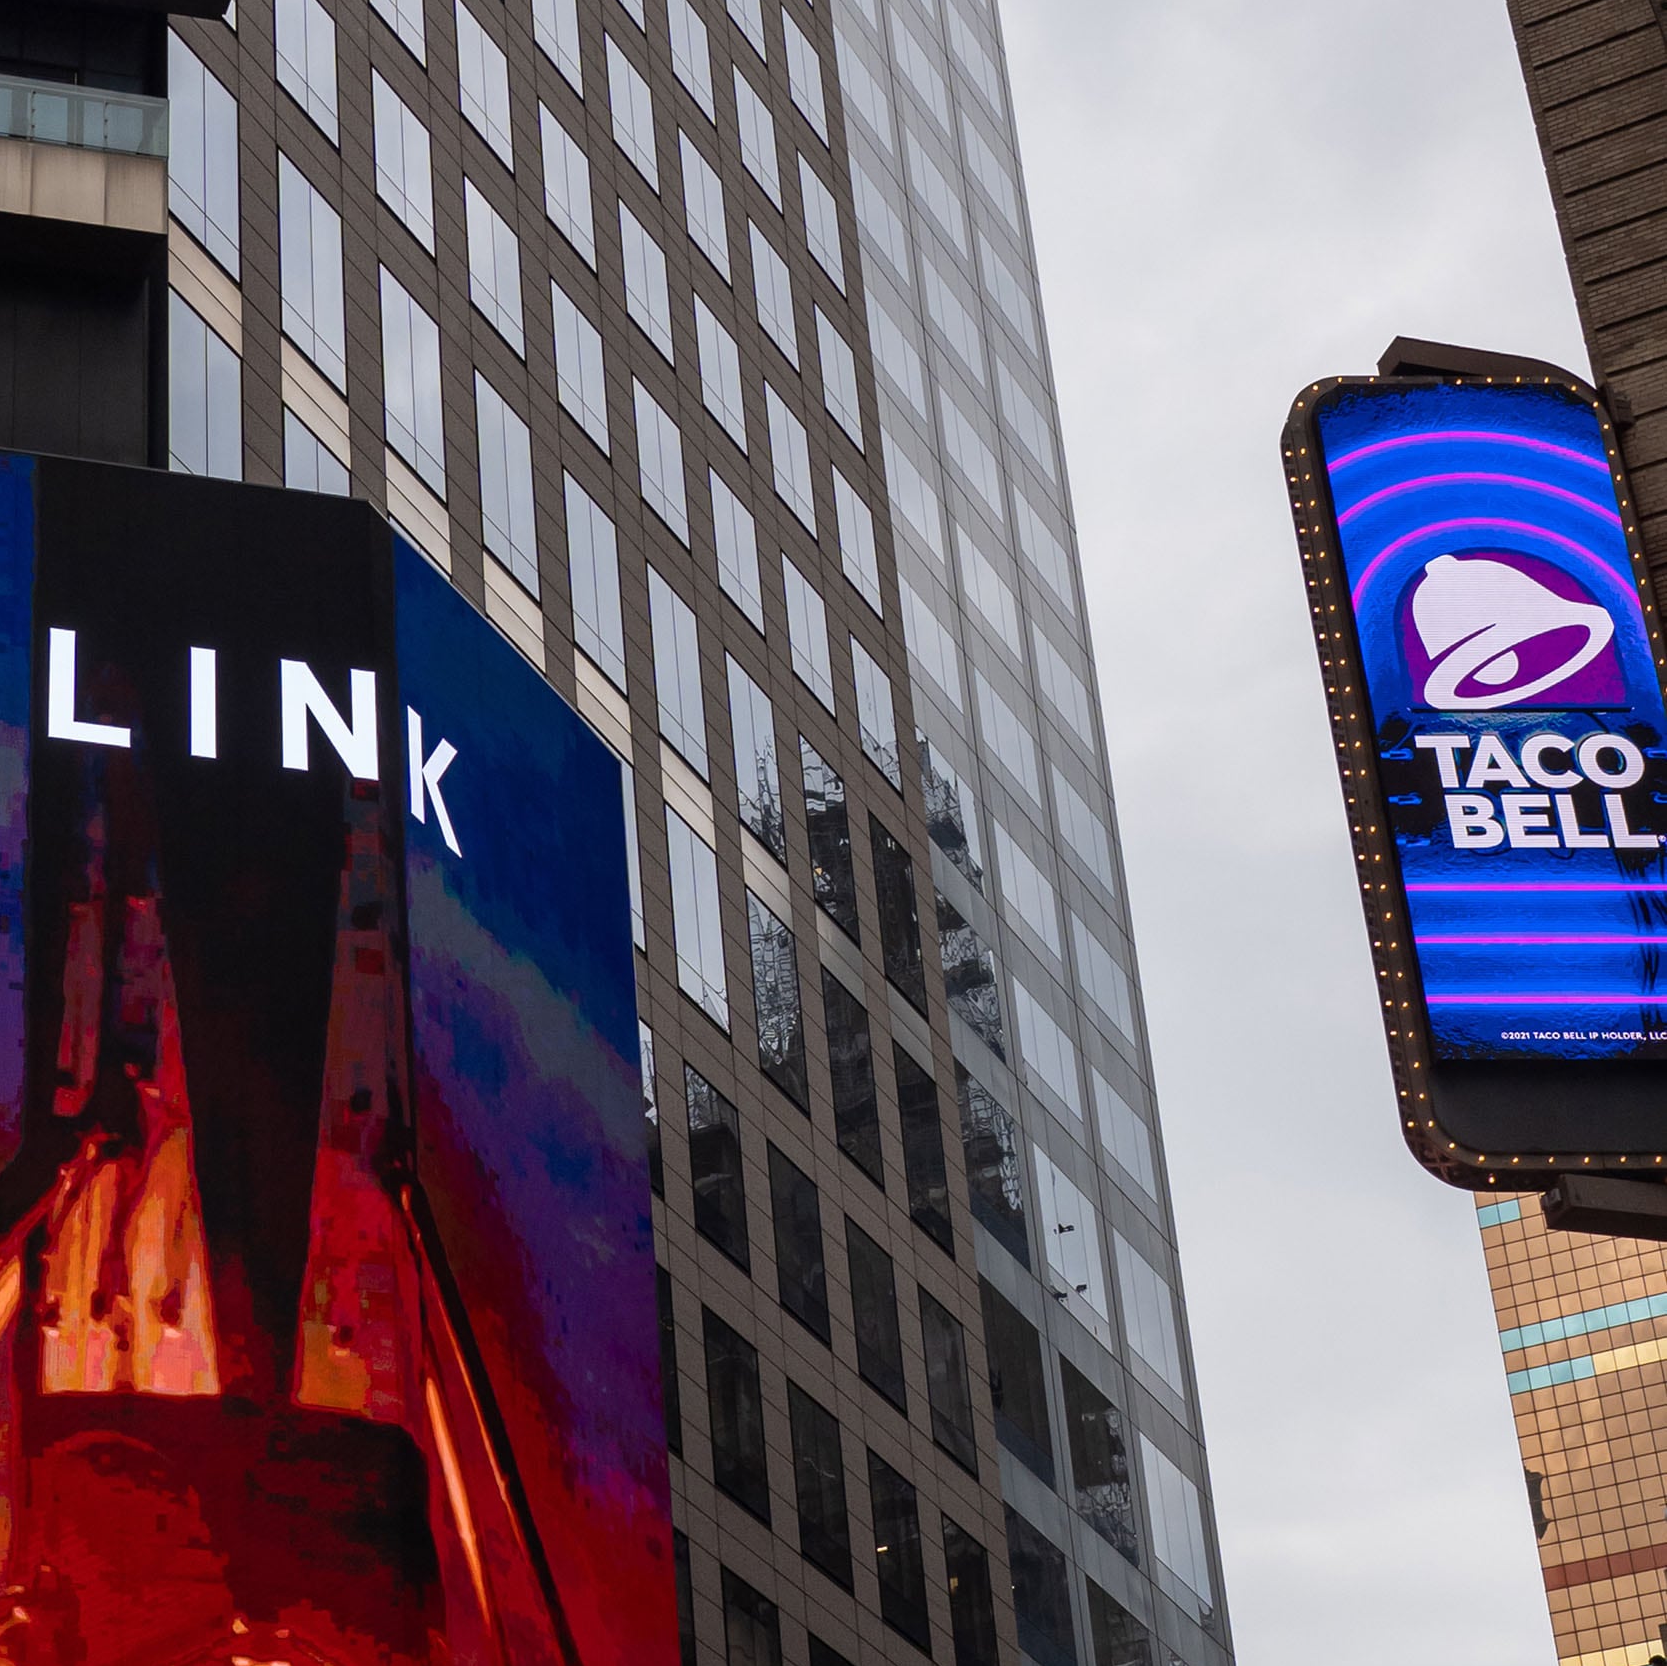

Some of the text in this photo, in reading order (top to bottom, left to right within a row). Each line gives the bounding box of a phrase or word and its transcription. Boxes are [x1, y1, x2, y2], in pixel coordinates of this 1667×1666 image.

[1414, 733, 1645, 789] TACO
[1533, 1031, 1561, 1040] TACO
[1562, 1031, 1586, 1040] BELL
[1589, 1031, 1599, 1040] IP
